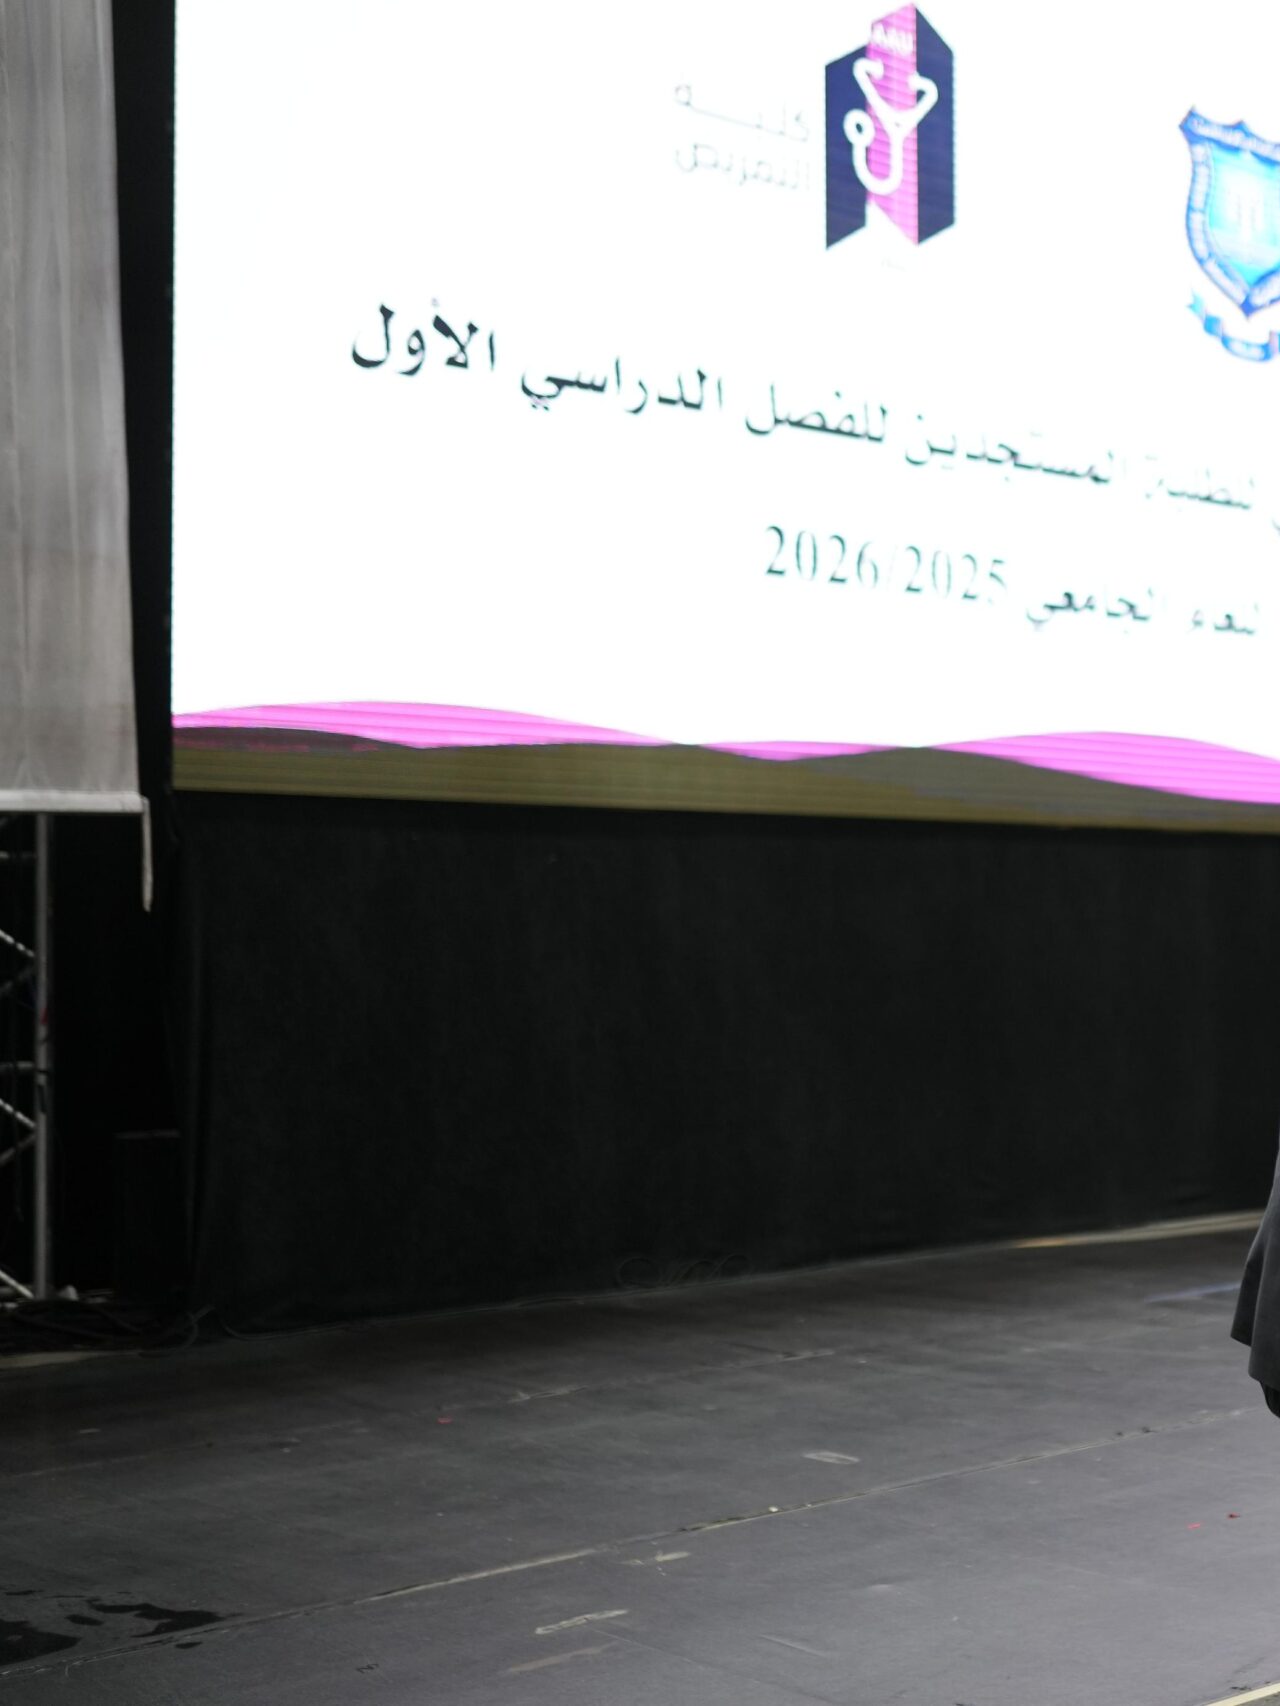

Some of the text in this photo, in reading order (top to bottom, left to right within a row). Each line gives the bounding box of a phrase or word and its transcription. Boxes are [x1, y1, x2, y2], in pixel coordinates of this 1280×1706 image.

[518, 355, 725, 417] الدراسي
[743, 382, 889, 445] للفصل
[903, 411, 1127, 487] المستجدين
